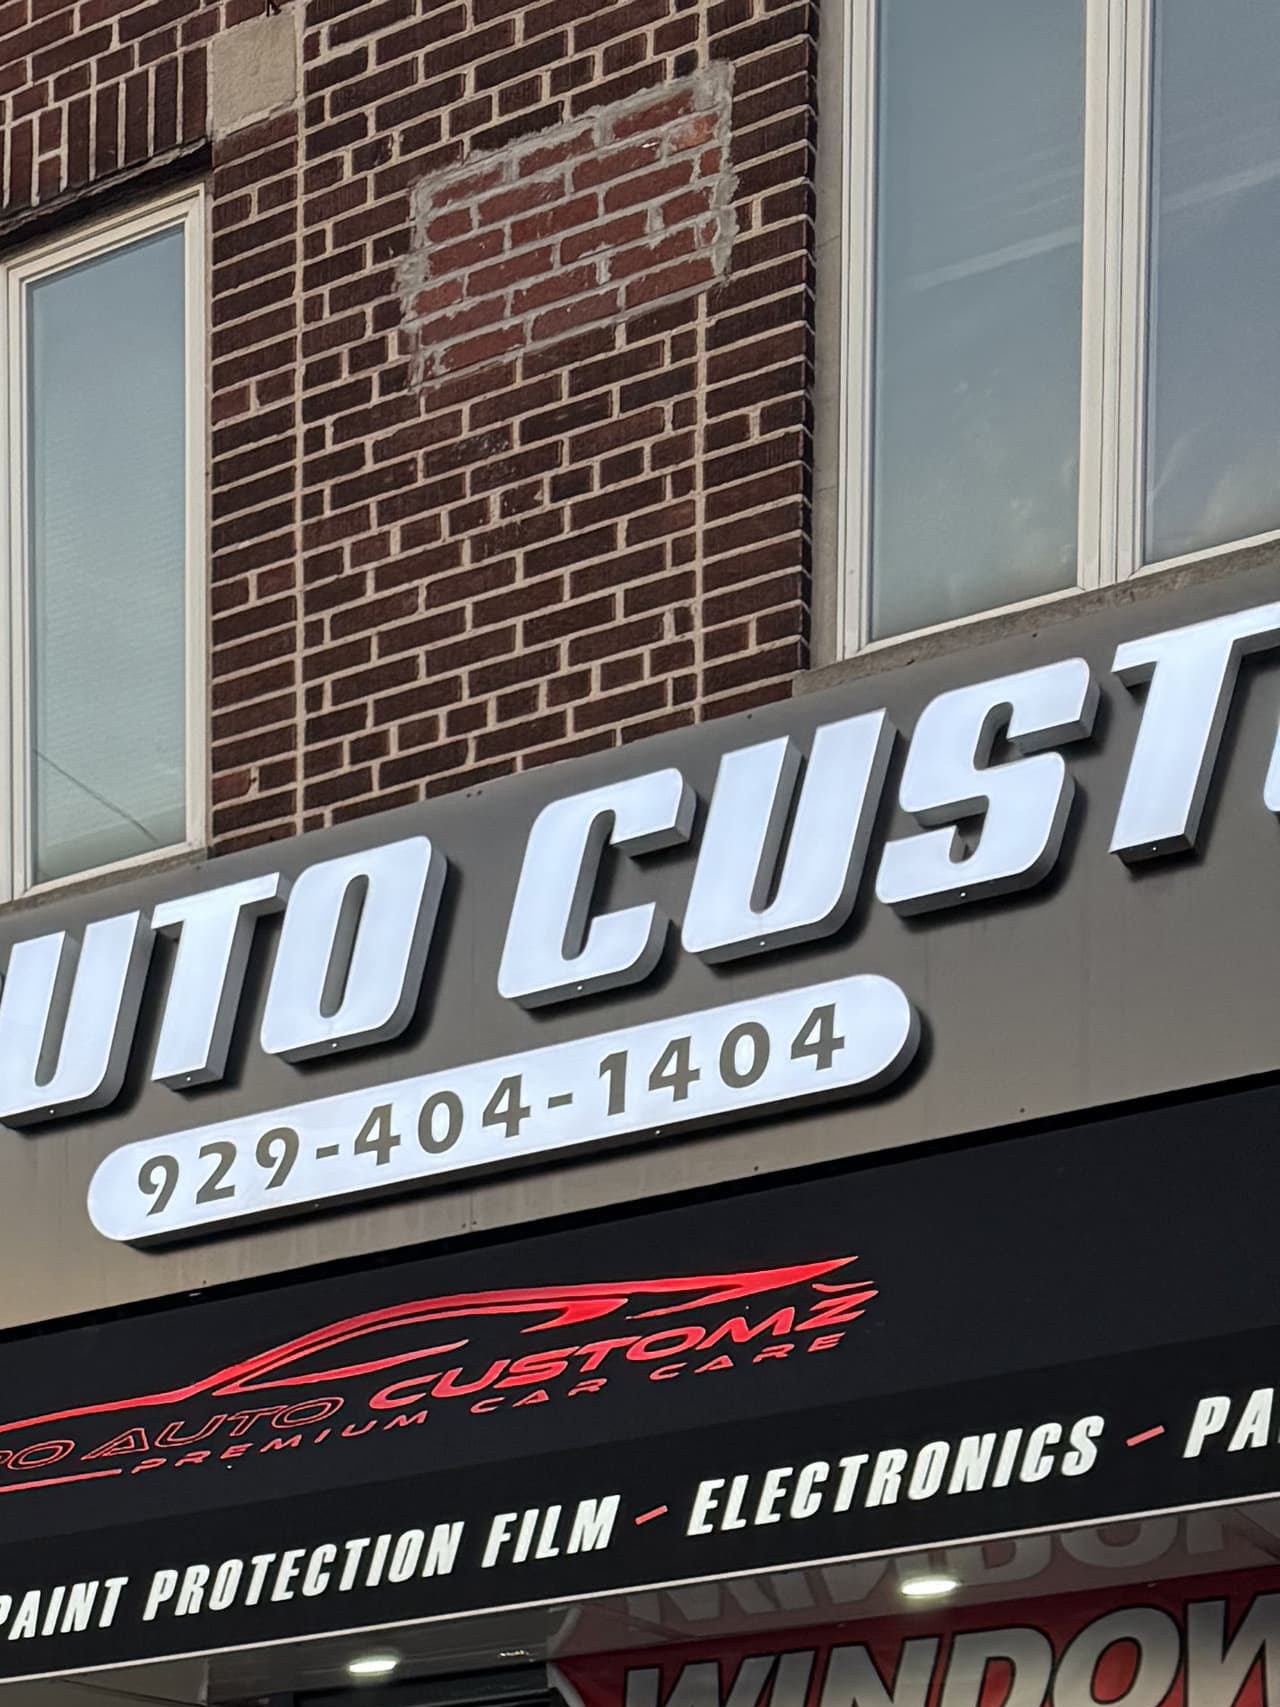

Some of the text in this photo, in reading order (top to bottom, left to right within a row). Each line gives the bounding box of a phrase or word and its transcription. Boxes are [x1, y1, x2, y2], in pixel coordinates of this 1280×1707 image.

[497, 600, 1280, 1005] CUST
[138, 1002, 847, 1217] 929-404-1404
[81, 1396, 345, 1460] AUTO
[131, 1332, 846, 1475] PREMIUM CAR CARE
[142, 1520, 465, 1622] PROTECTION
[481, 1494, 623, 1569] FILM
[685, 1416, 1106, 1537] ELECTRONICS
[1183, 1387, 1280, 1459] PA
